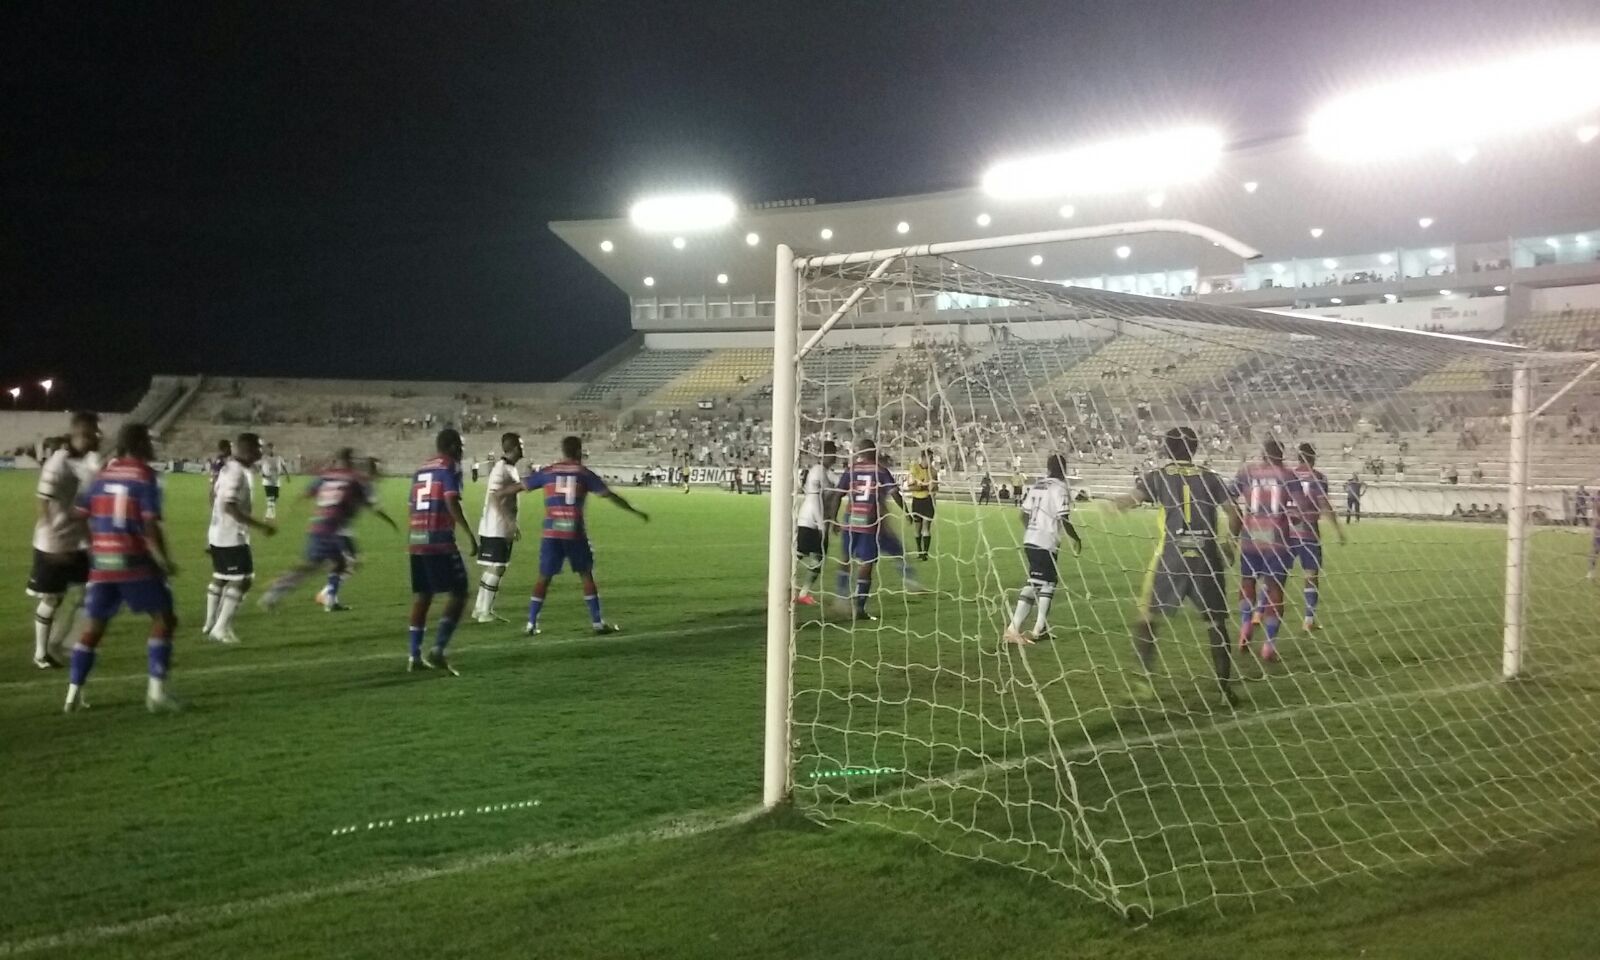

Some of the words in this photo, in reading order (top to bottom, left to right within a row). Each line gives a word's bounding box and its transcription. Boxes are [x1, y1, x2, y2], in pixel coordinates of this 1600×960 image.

[416, 472, 433, 511] 2
[555, 475, 577, 505] 4
[856, 474, 872, 502] 3
[1183, 484, 1191, 524] 1
